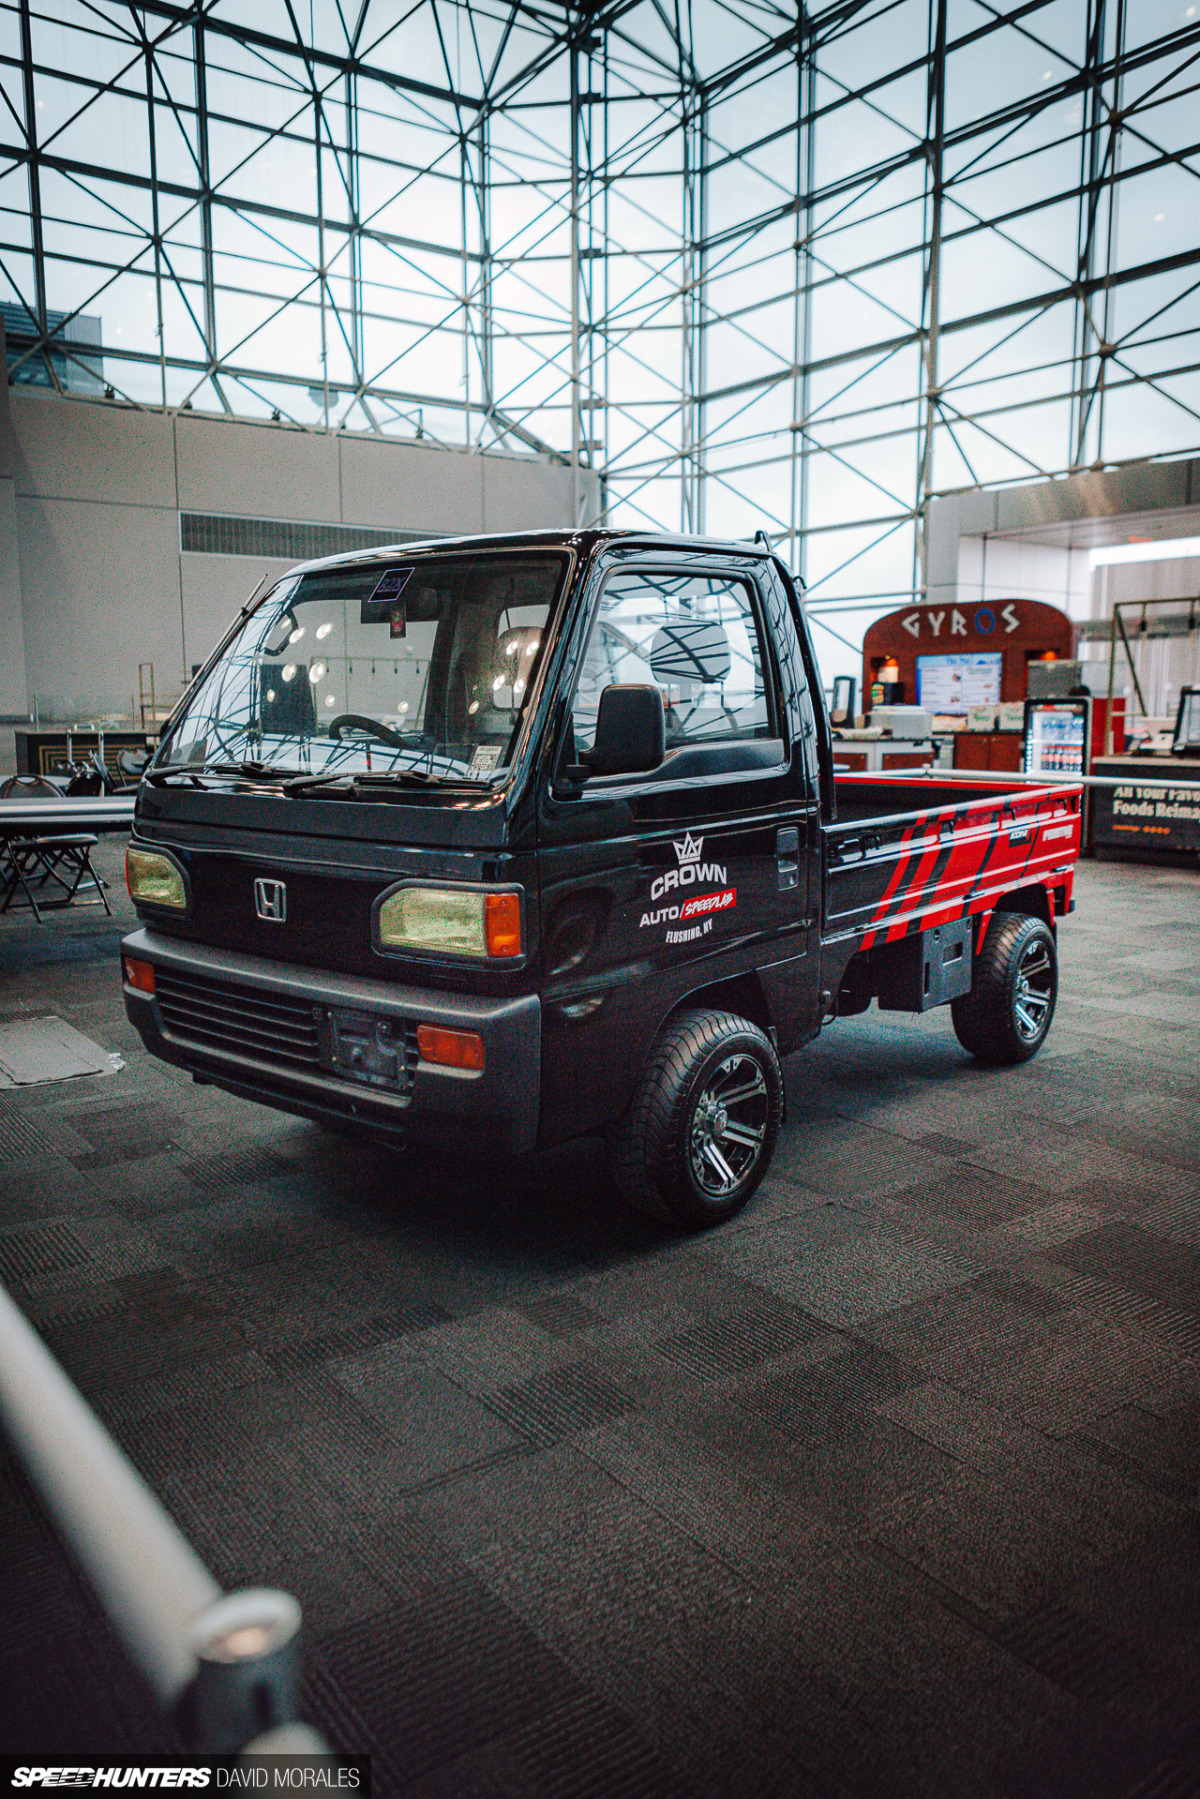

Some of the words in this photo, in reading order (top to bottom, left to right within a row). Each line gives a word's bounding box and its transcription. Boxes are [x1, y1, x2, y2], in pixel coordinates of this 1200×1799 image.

[901, 603, 1020, 639] GYROS
[1113, 800, 1154, 816] Foods
[651, 863, 727, 900] CROWN
[639, 905, 679, 927] AUTO
[685, 892, 734, 916] SPEEDLAB
[665, 925, 702, 943] FLUSHING,
[703, 918, 713, 933] NY
